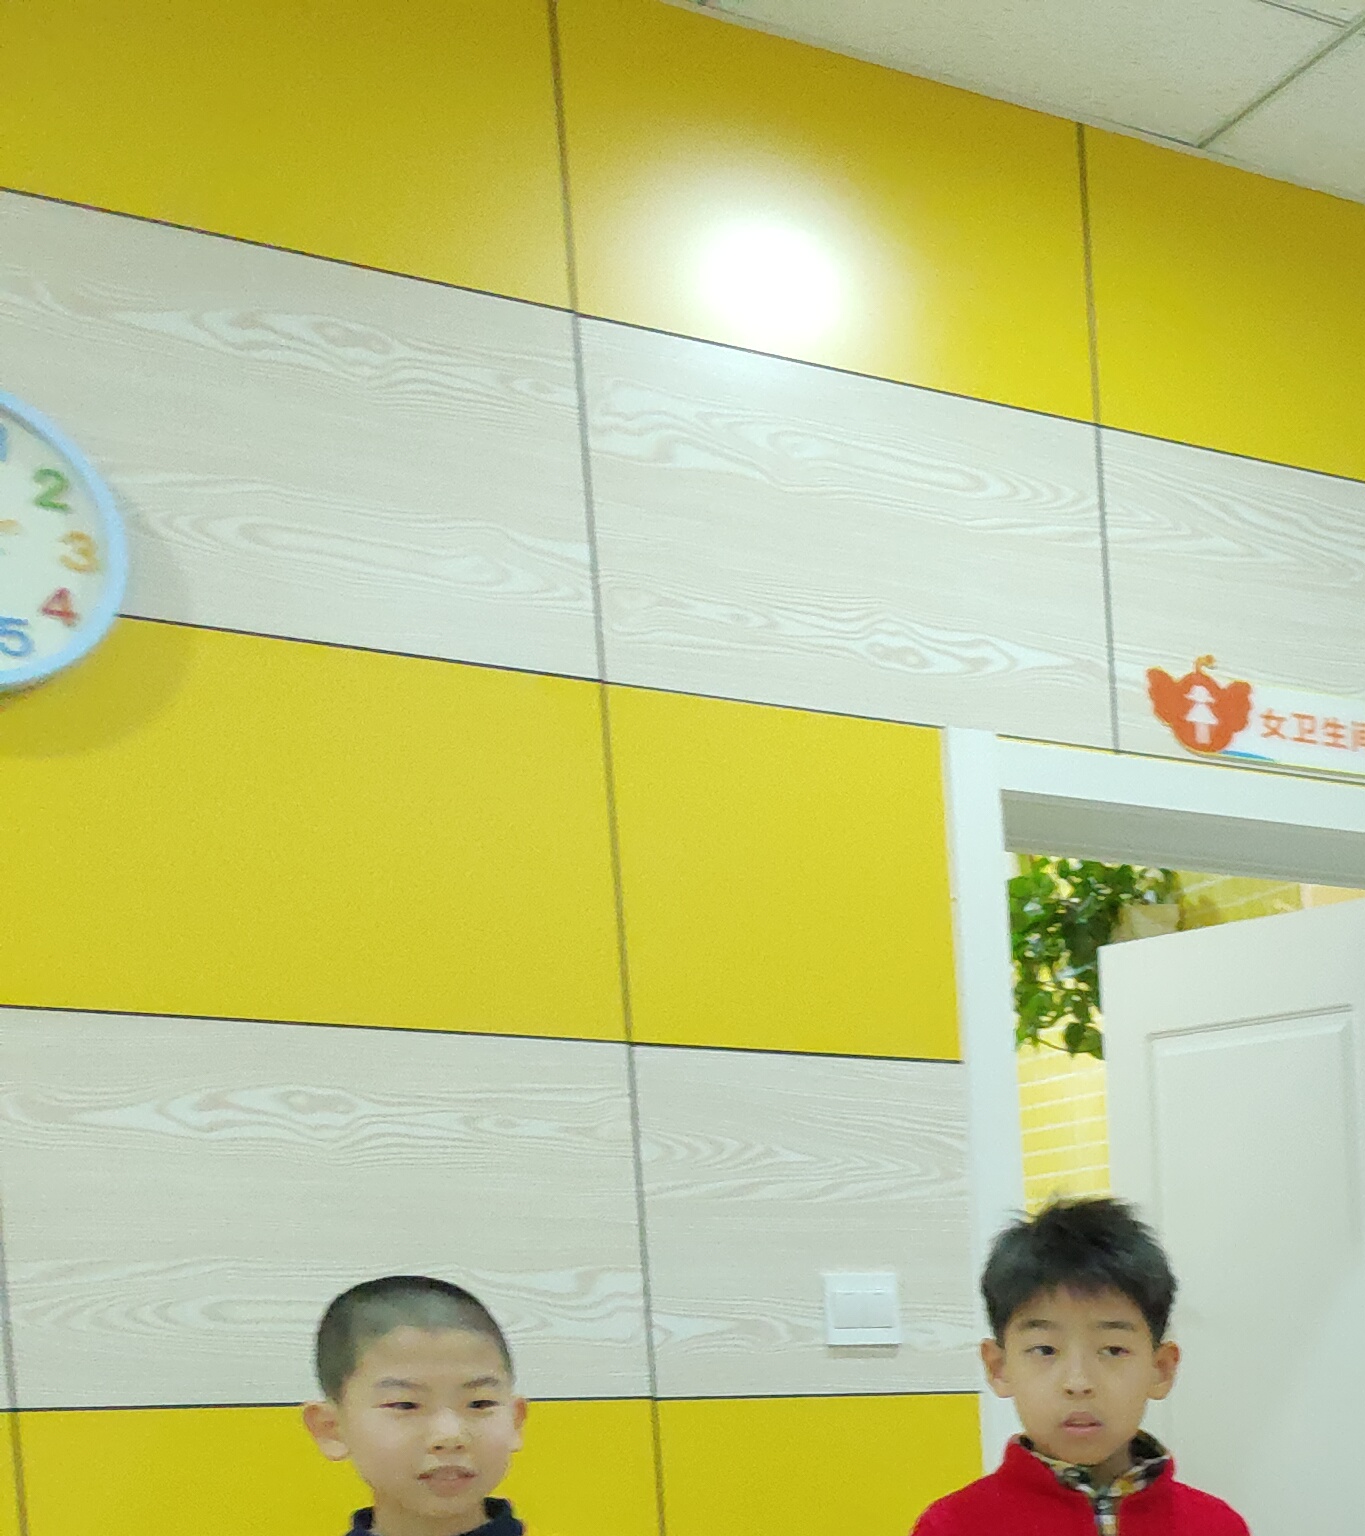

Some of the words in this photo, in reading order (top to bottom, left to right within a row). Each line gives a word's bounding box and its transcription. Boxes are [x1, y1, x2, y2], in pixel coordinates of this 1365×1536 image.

[33, 468, 71, 513] 2
[59, 531, 99, 573] 3
[41, 587, 80, 628] 4
